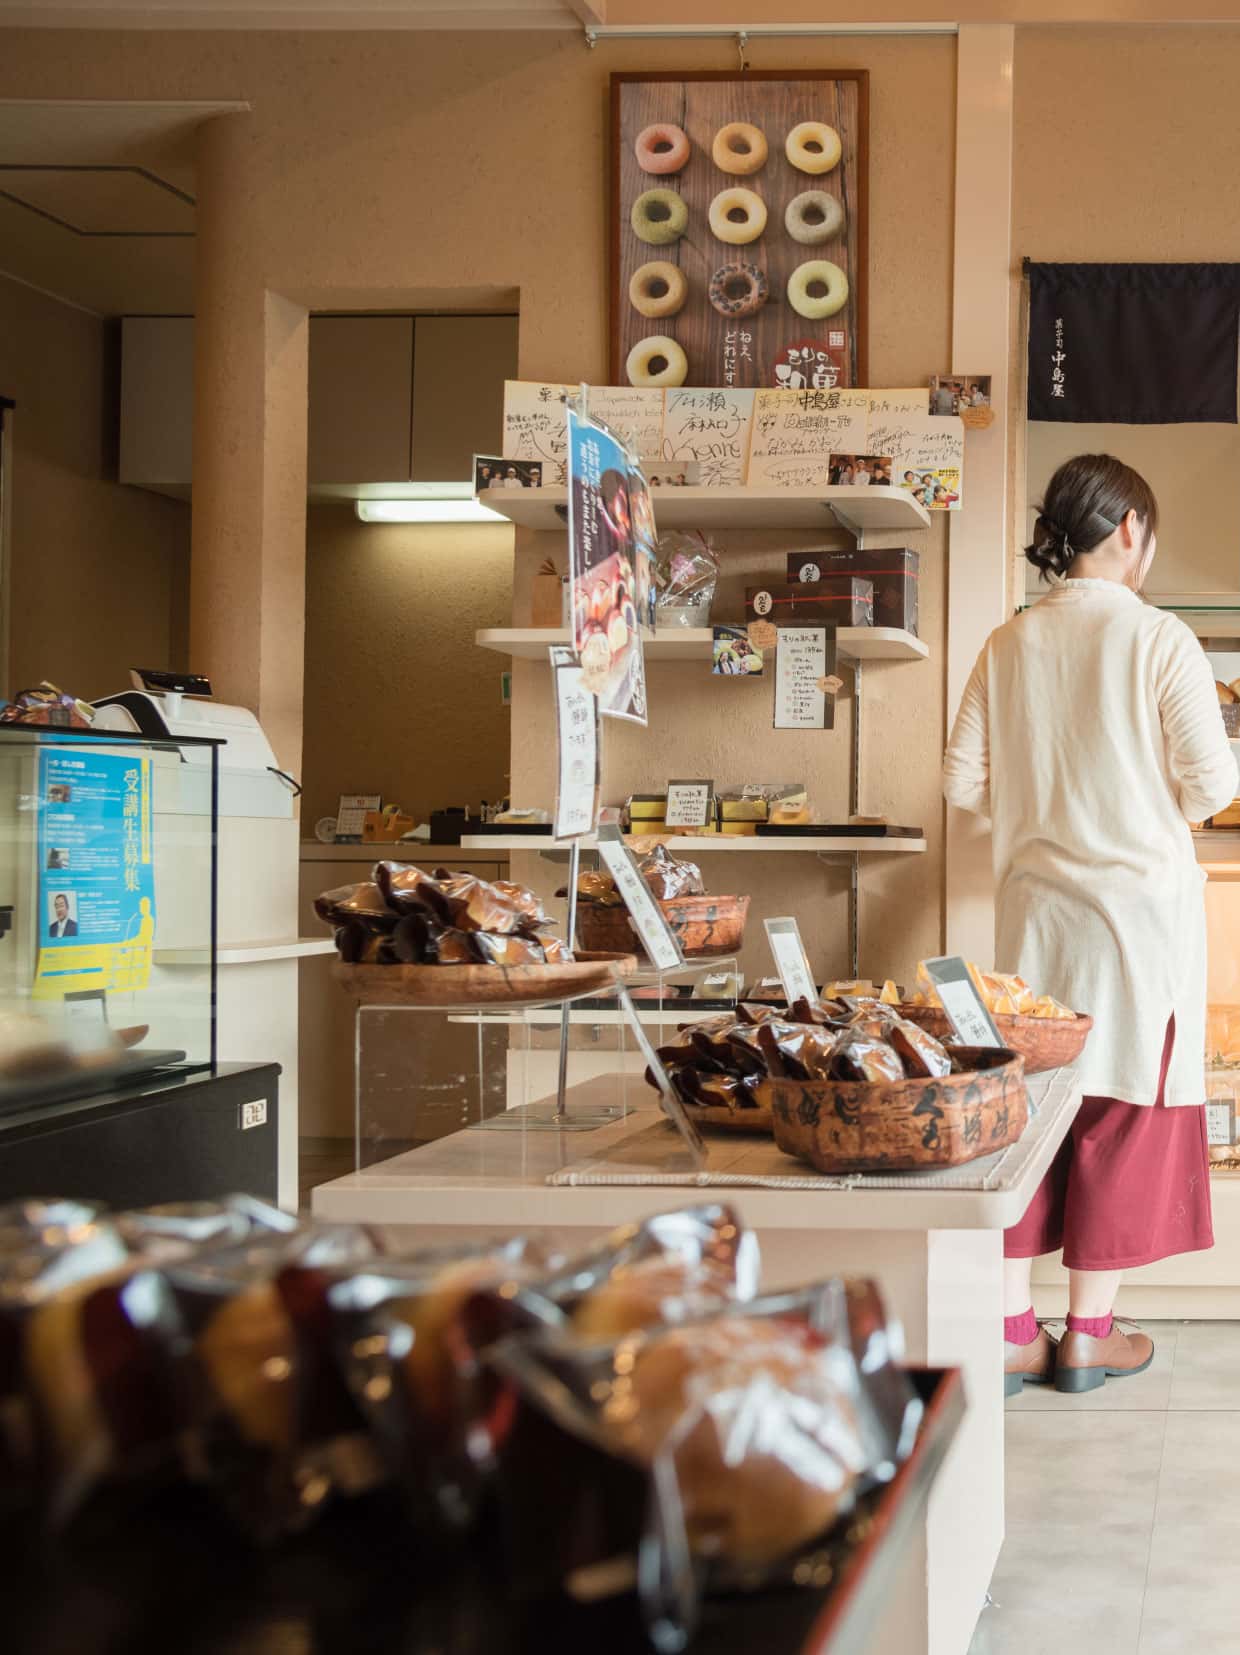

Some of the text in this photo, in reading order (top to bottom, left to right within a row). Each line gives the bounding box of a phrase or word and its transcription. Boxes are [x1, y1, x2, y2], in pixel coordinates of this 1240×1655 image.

[723, 330, 737, 388] どれにす
[787, 346, 829, 365] もりの
[1051, 350, 1067, 398] 中島屋
[123, 769, 141, 892] 受講生募集
